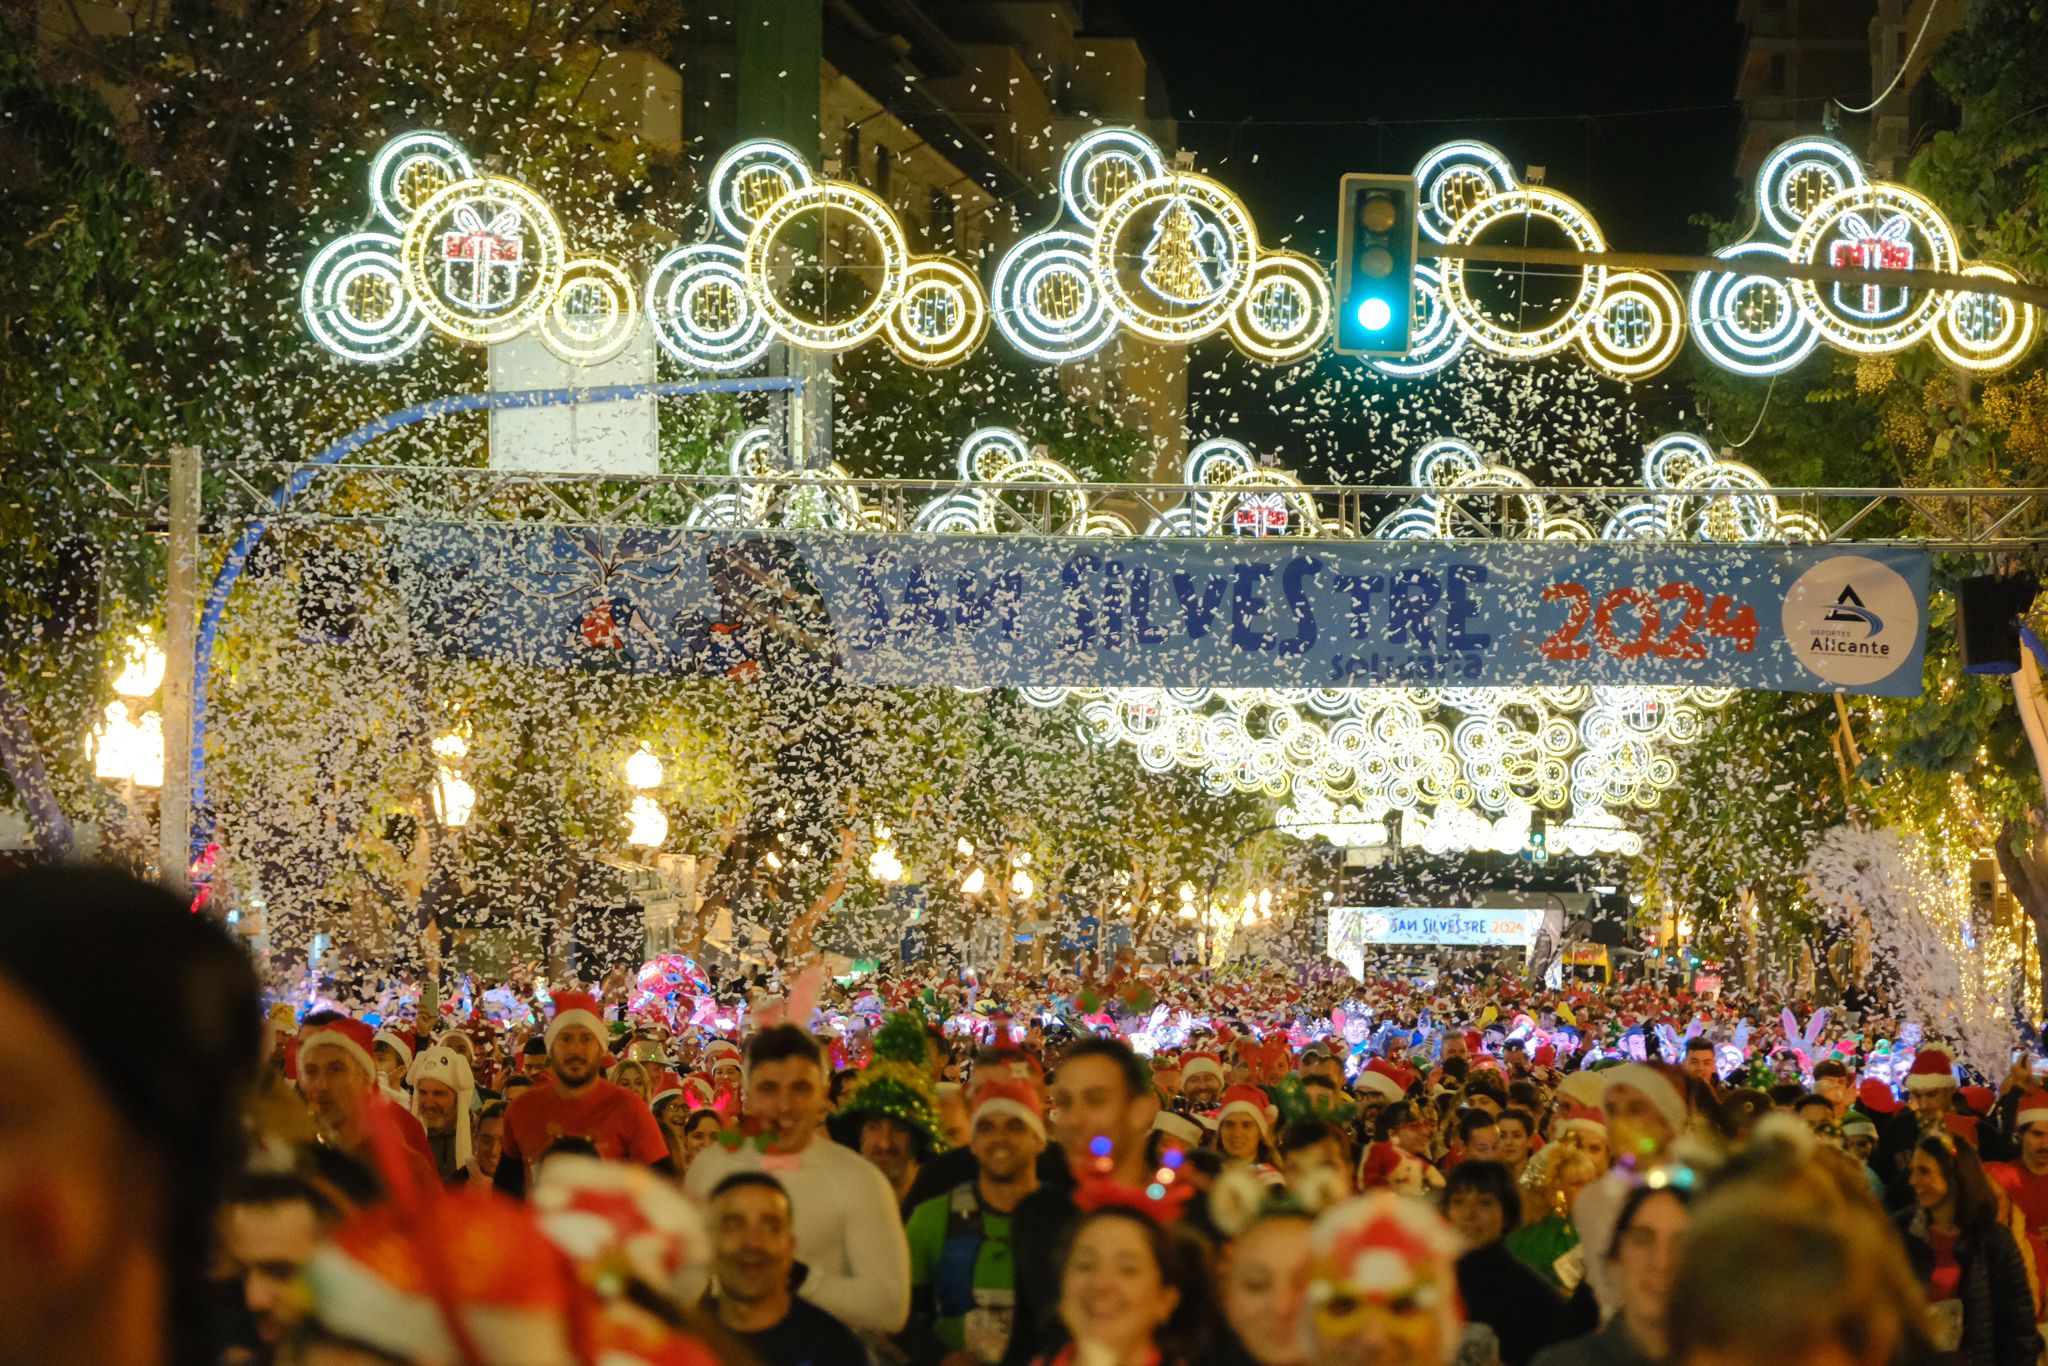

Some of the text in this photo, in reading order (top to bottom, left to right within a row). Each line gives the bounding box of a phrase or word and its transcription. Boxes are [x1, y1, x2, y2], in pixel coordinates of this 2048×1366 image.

[1539, 581, 1760, 660] 2024
[1810, 629, 1851, 637] DEPORTES
[1810, 637, 1890, 655] Alicante
[1392, 919, 1418, 933] SAN
[1491, 920, 1525, 935] 2024
